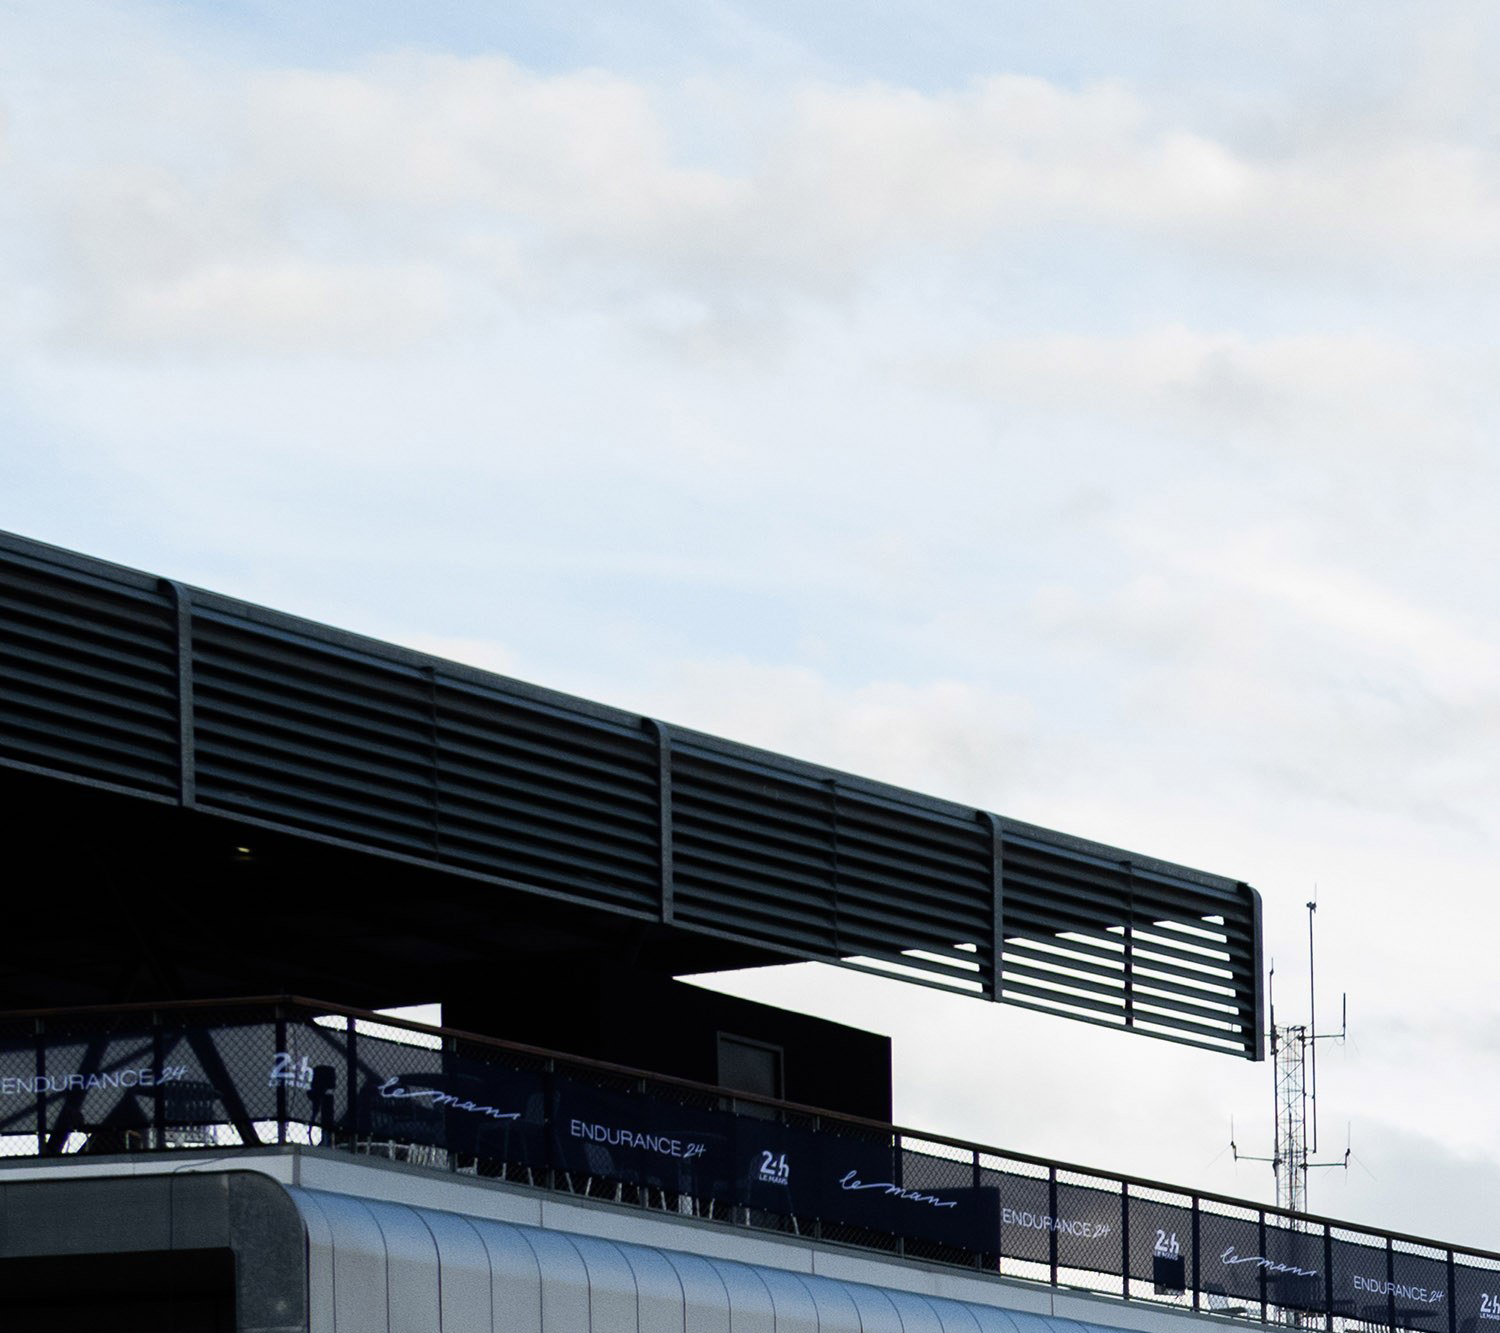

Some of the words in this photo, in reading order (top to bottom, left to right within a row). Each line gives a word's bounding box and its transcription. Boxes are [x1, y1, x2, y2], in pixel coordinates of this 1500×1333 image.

[570, 1119, 681, 1158] ENDURANCE
[1002, 1207, 1091, 1237] ENDURANCE
[1353, 1275, 1427, 1302] ENDURANCE
